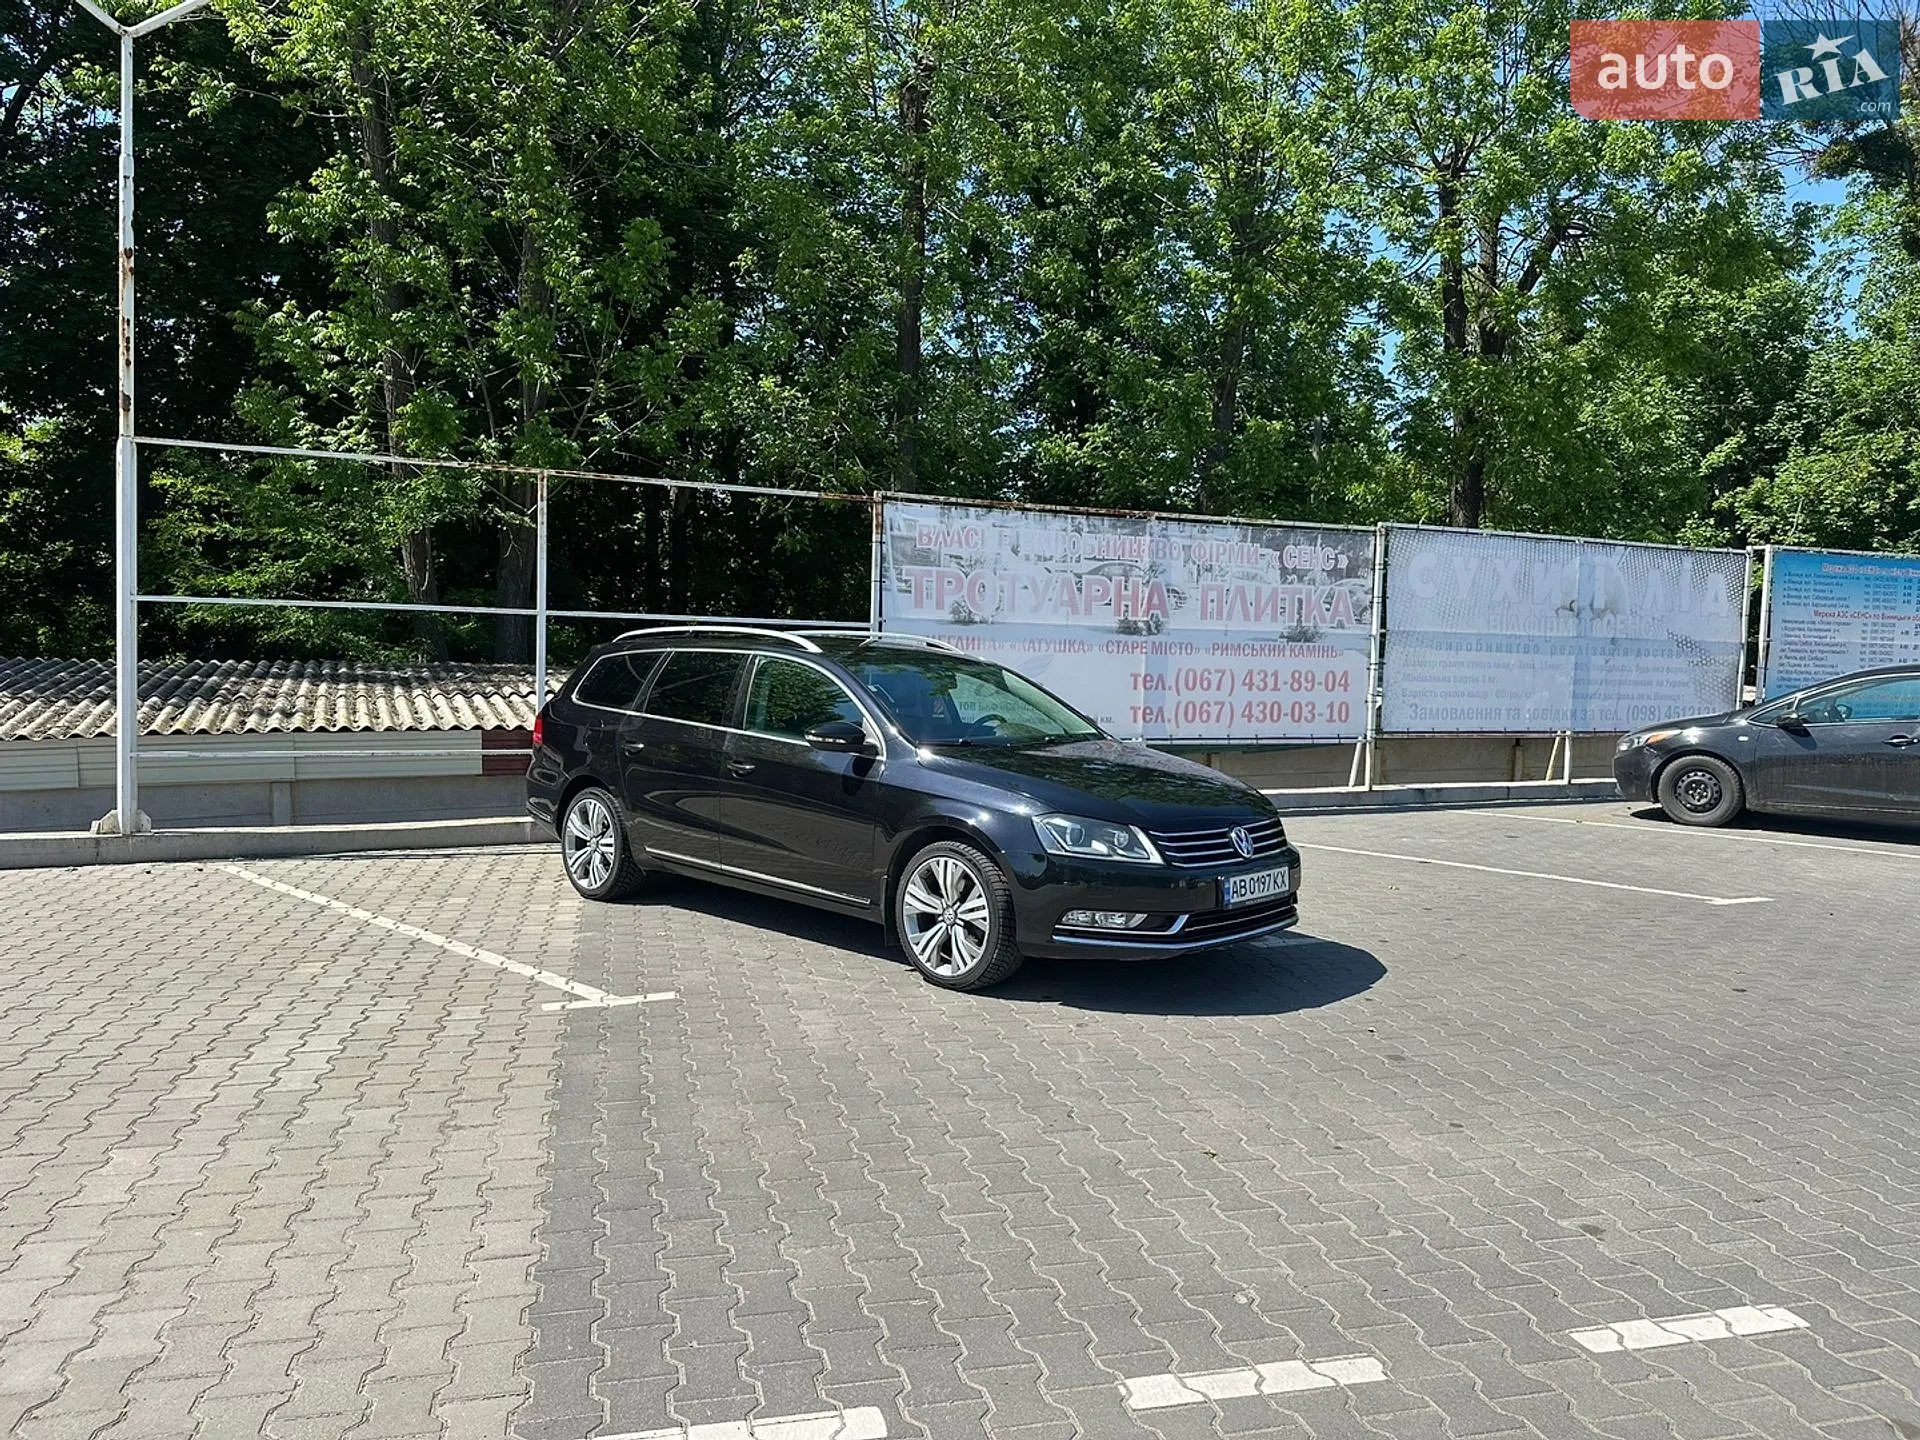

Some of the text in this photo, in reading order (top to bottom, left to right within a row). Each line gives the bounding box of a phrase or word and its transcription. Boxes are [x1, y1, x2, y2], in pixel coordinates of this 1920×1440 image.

[1191, 541, 1260, 565] ФІРМИ
[903, 568, 1354, 625] ТРОТУАРНА ПЛИТКА
[1100, 639, 1147, 655] «СТАРЕ
[1150, 641, 1199, 656] МІСТО»
[1289, 643, 1344, 659] КАМІНЬ»
[1130, 668, 1350, 696] тел.(067) 431-89-04
[1129, 700, 1350, 729] тел.(067) 430-03-10
[1409, 703, 1501, 721] Замовлення
[1506, 705, 1521, 721] та
[1599, 708, 1622, 721] тел.
[1626, 704, 1661, 724] (098)
